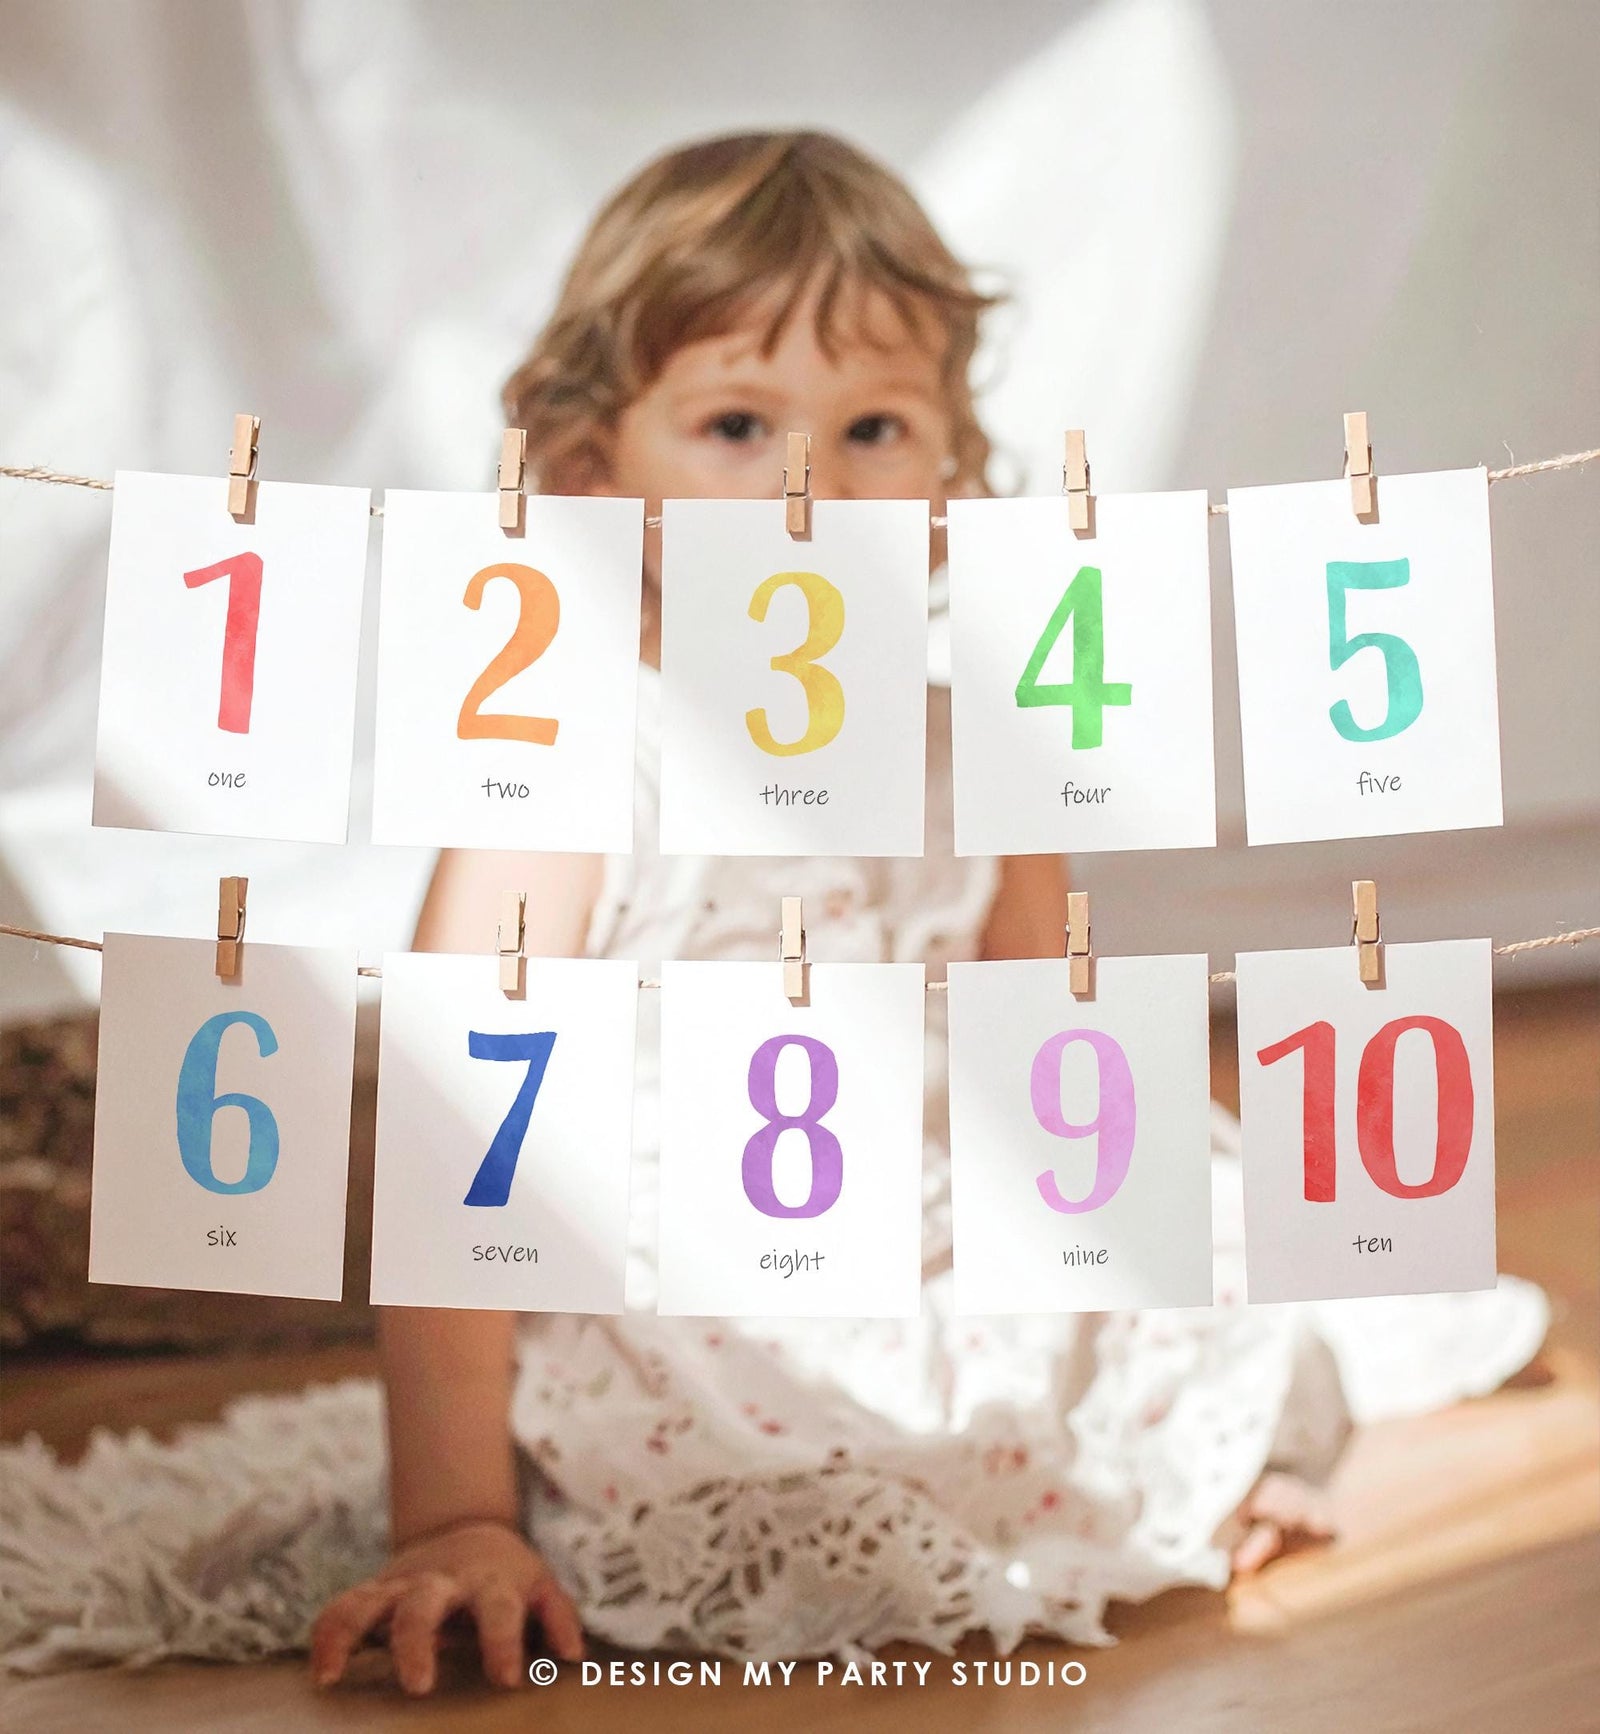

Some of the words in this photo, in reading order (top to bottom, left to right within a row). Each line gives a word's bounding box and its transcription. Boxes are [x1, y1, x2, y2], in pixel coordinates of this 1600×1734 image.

[184, 552, 263, 734] 1
[457, 563, 560, 746] 2
[745, 572, 845, 757] 3
[1016, 567, 1131, 749] 4
[1326, 558, 1423, 742] 5
[208, 772, 246, 788] one
[481, 778, 529, 799] two
[759, 784, 829, 806] three
[1061, 781, 1111, 807] four
[1356, 771, 1401, 796] five
[177, 1012, 279, 1194] 6
[464, 1031, 557, 1207] 7
[742, 1035, 842, 1218] 8
[1033, 1032, 1134, 1211] 9
[1257, 1015, 1474, 1203] 10
[207, 1225, 237, 1247] six
[472, 1245, 538, 1263] seven
[760, 1249, 825, 1279] eight
[1063, 1245, 1109, 1266] nine
[1352, 1235, 1392, 1253] ten
